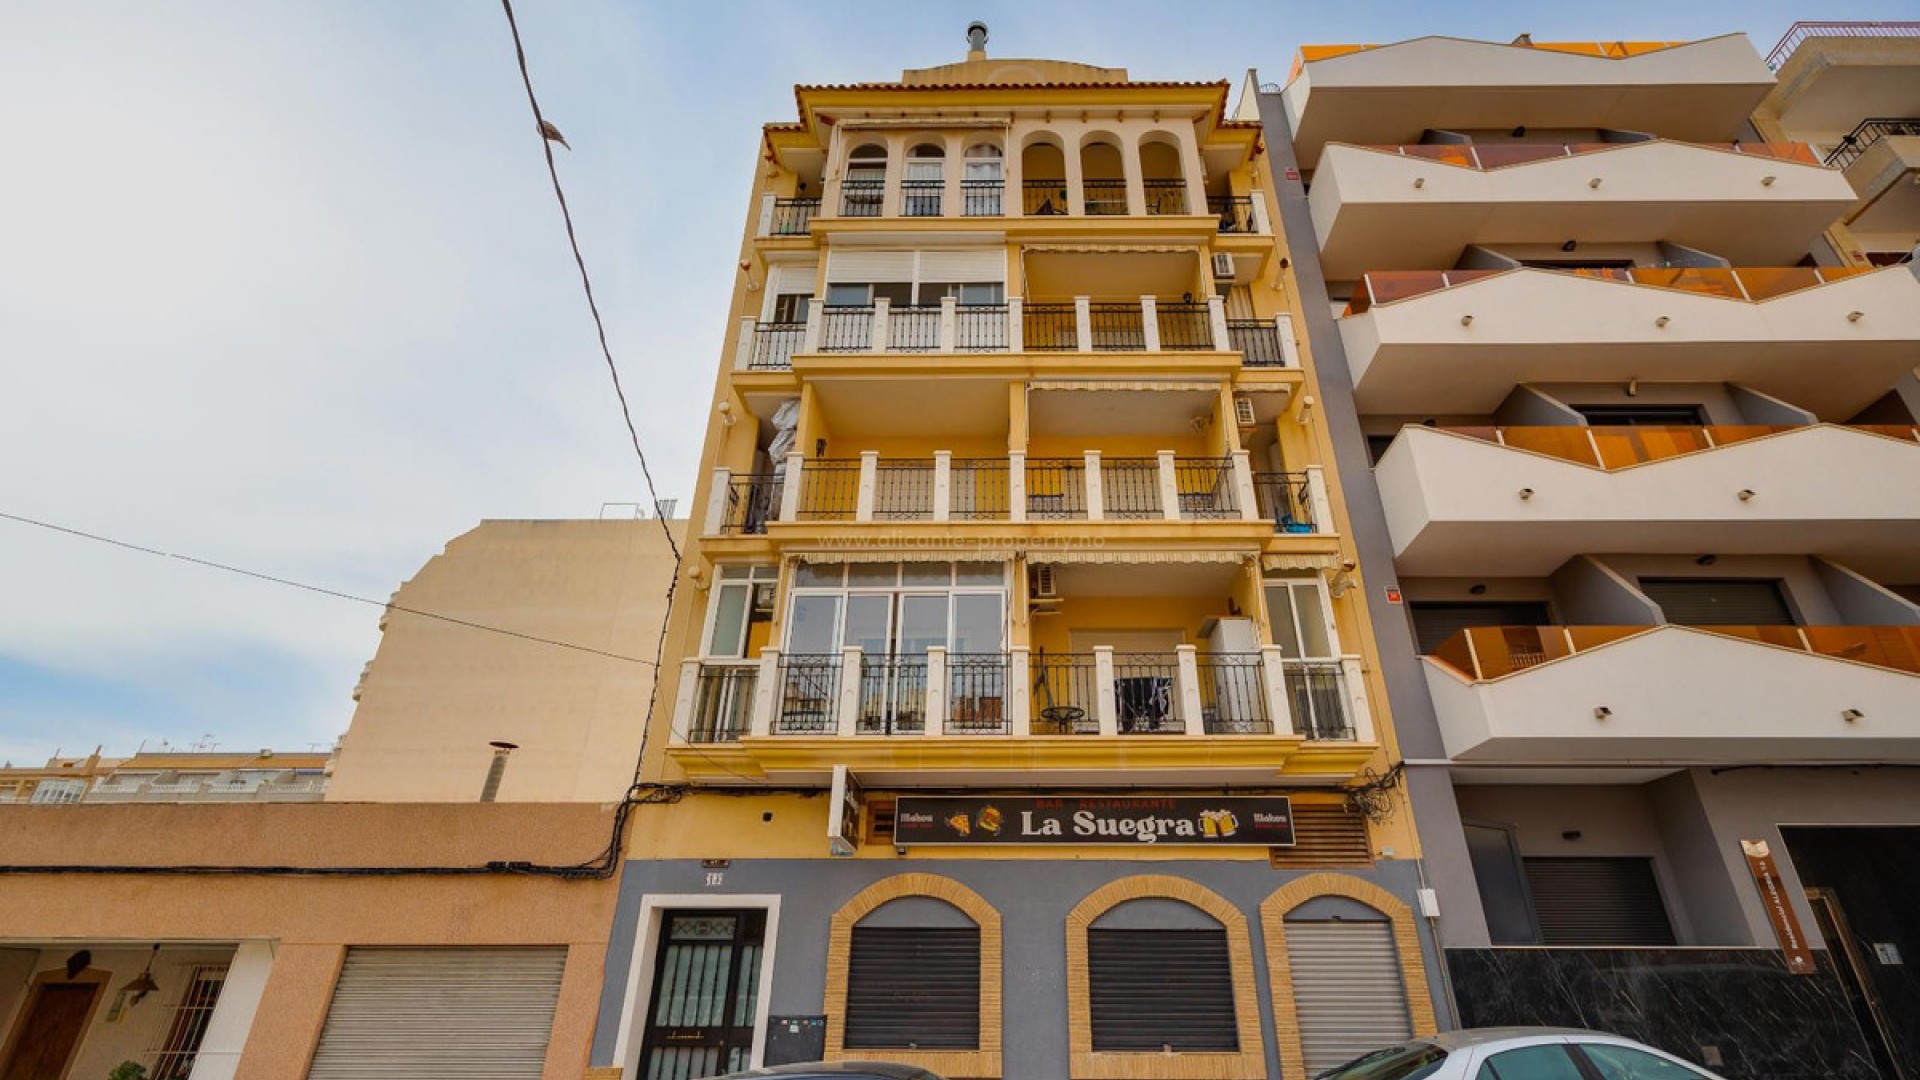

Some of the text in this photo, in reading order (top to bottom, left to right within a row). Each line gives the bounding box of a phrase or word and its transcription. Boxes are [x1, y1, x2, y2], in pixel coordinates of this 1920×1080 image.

[1035, 799, 1177, 810] BAR RESTAURANTE
[1020, 809, 1197, 844] La Suegra
